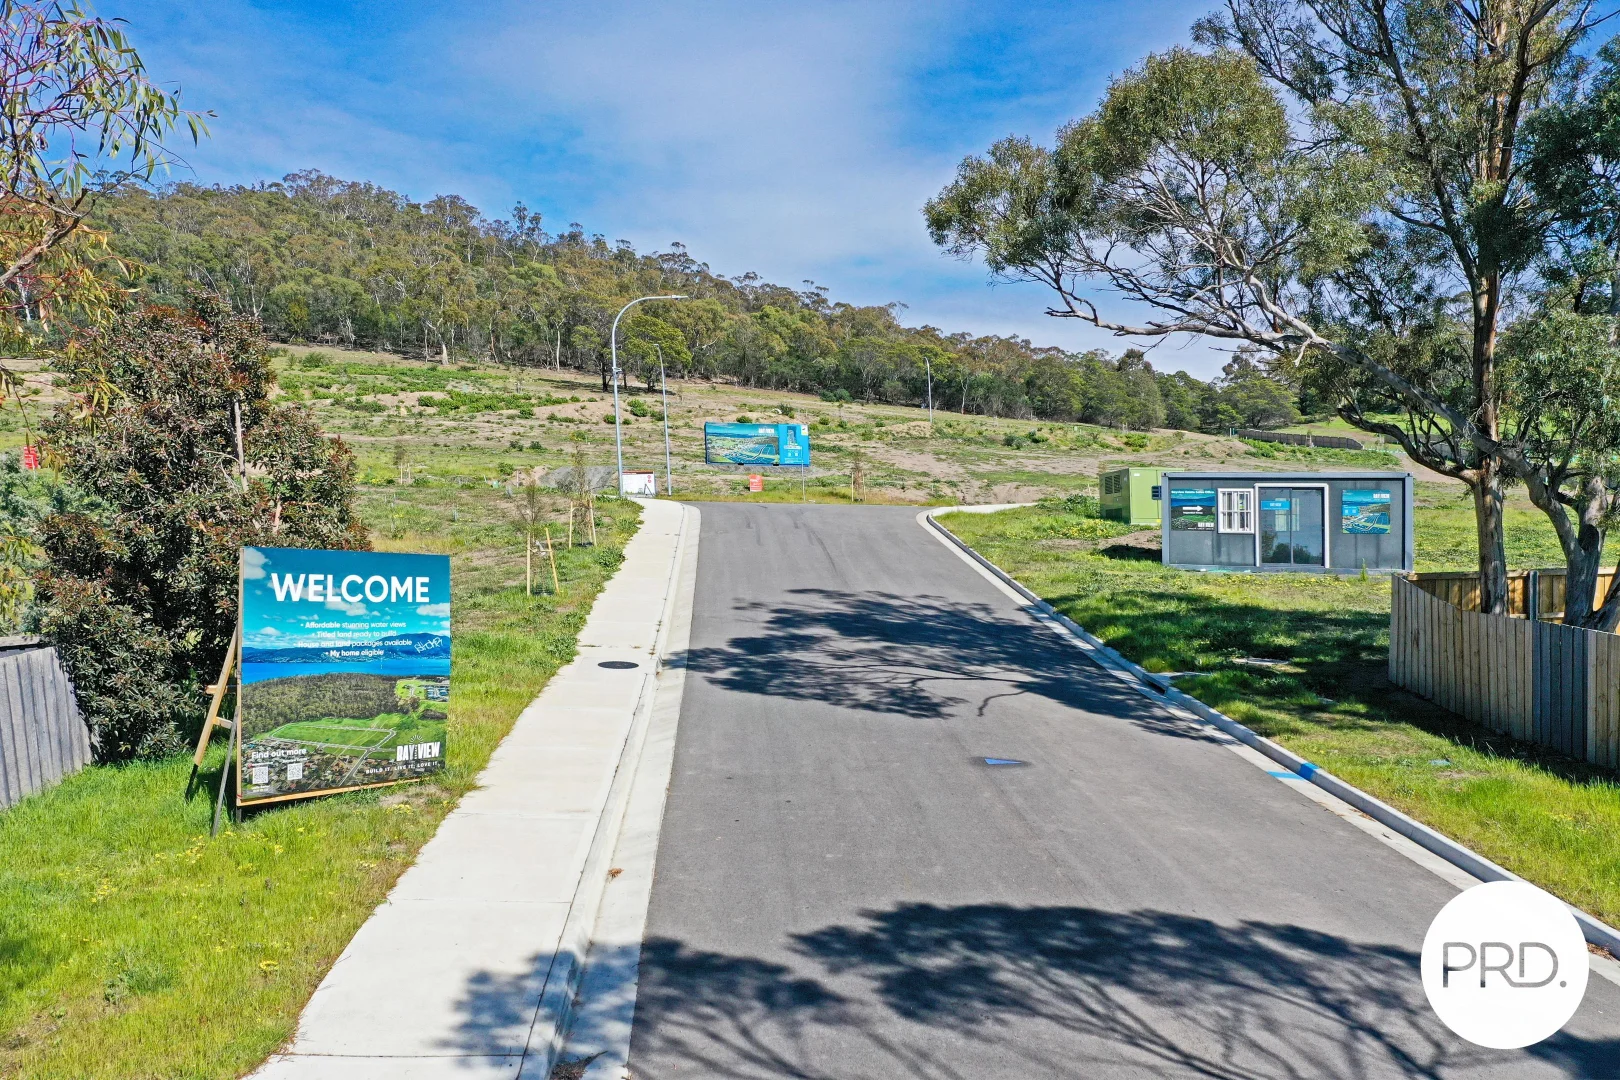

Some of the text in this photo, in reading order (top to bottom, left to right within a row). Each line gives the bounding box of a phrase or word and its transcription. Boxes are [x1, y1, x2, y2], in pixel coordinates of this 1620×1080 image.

[271, 572, 430, 602] WELCOME
[351, 640, 383, 648] packages
[361, 649, 384, 657] eligible
[252, 751, 269, 759] Find
